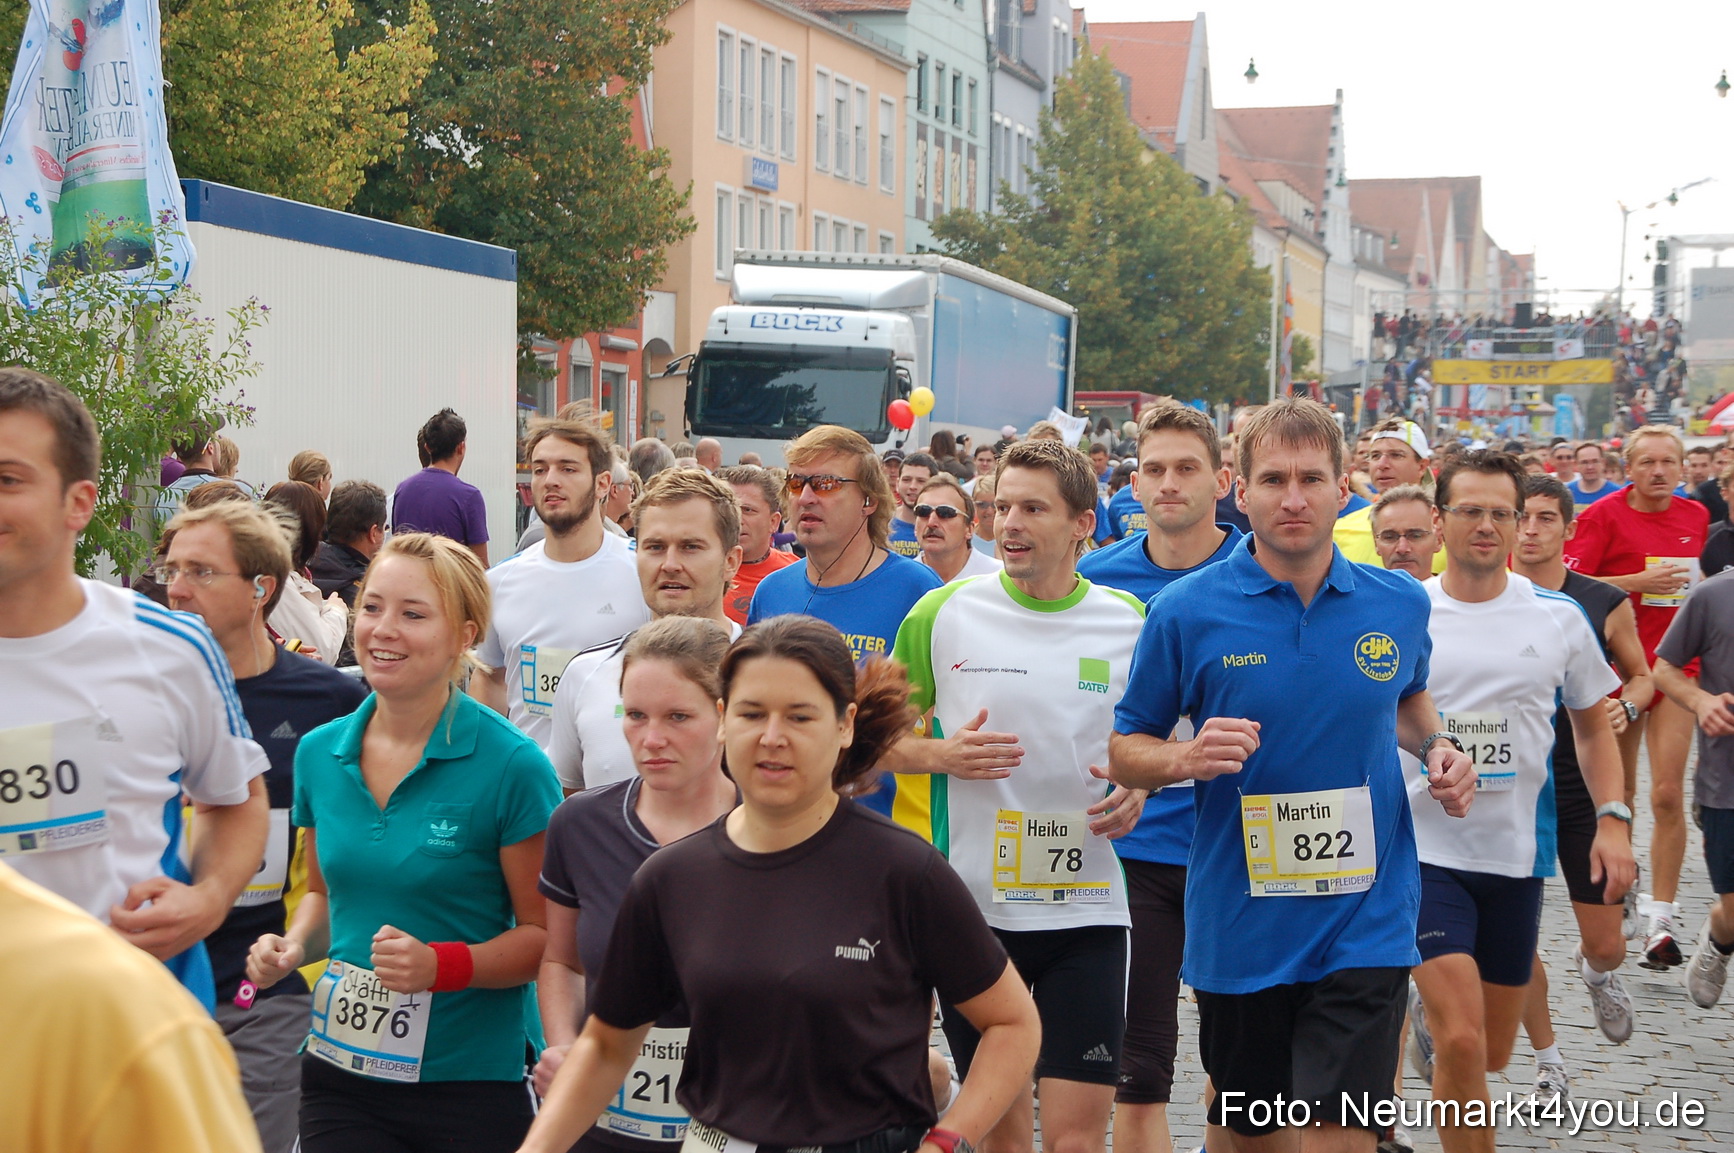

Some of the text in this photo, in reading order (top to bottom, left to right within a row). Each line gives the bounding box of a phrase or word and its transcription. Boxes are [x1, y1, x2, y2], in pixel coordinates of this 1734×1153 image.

[751, 312, 845, 332] BOCK
[1490, 364, 1551, 380] START
[1361, 637, 1393, 660] djk
[1222, 651, 1267, 669] Martin
[1000, 667, 1028, 675] nürnberg
[1078, 681, 1109, 694] DATEV
[1448, 718, 1508, 733] Bernhard
[1277, 802, 1331, 822] Martin
[1027, 819, 1068, 837] Heiko
[427, 838, 456, 848] adidas
[1250, 834, 1259, 849] C
[1293, 829, 1355, 862] 822
[999, 845, 1007, 858] C
[1047, 847, 1083, 873] 78
[1329, 873, 1374, 887] PFLEIDERER
[1066, 888, 1110, 897] PFLEIDERER
[835, 945, 870, 961] PUMA
[335, 997, 411, 1038] 3876
[1082, 1053, 1113, 1062] adidas
[366, 1057, 419, 1075] PFLEIDERER
